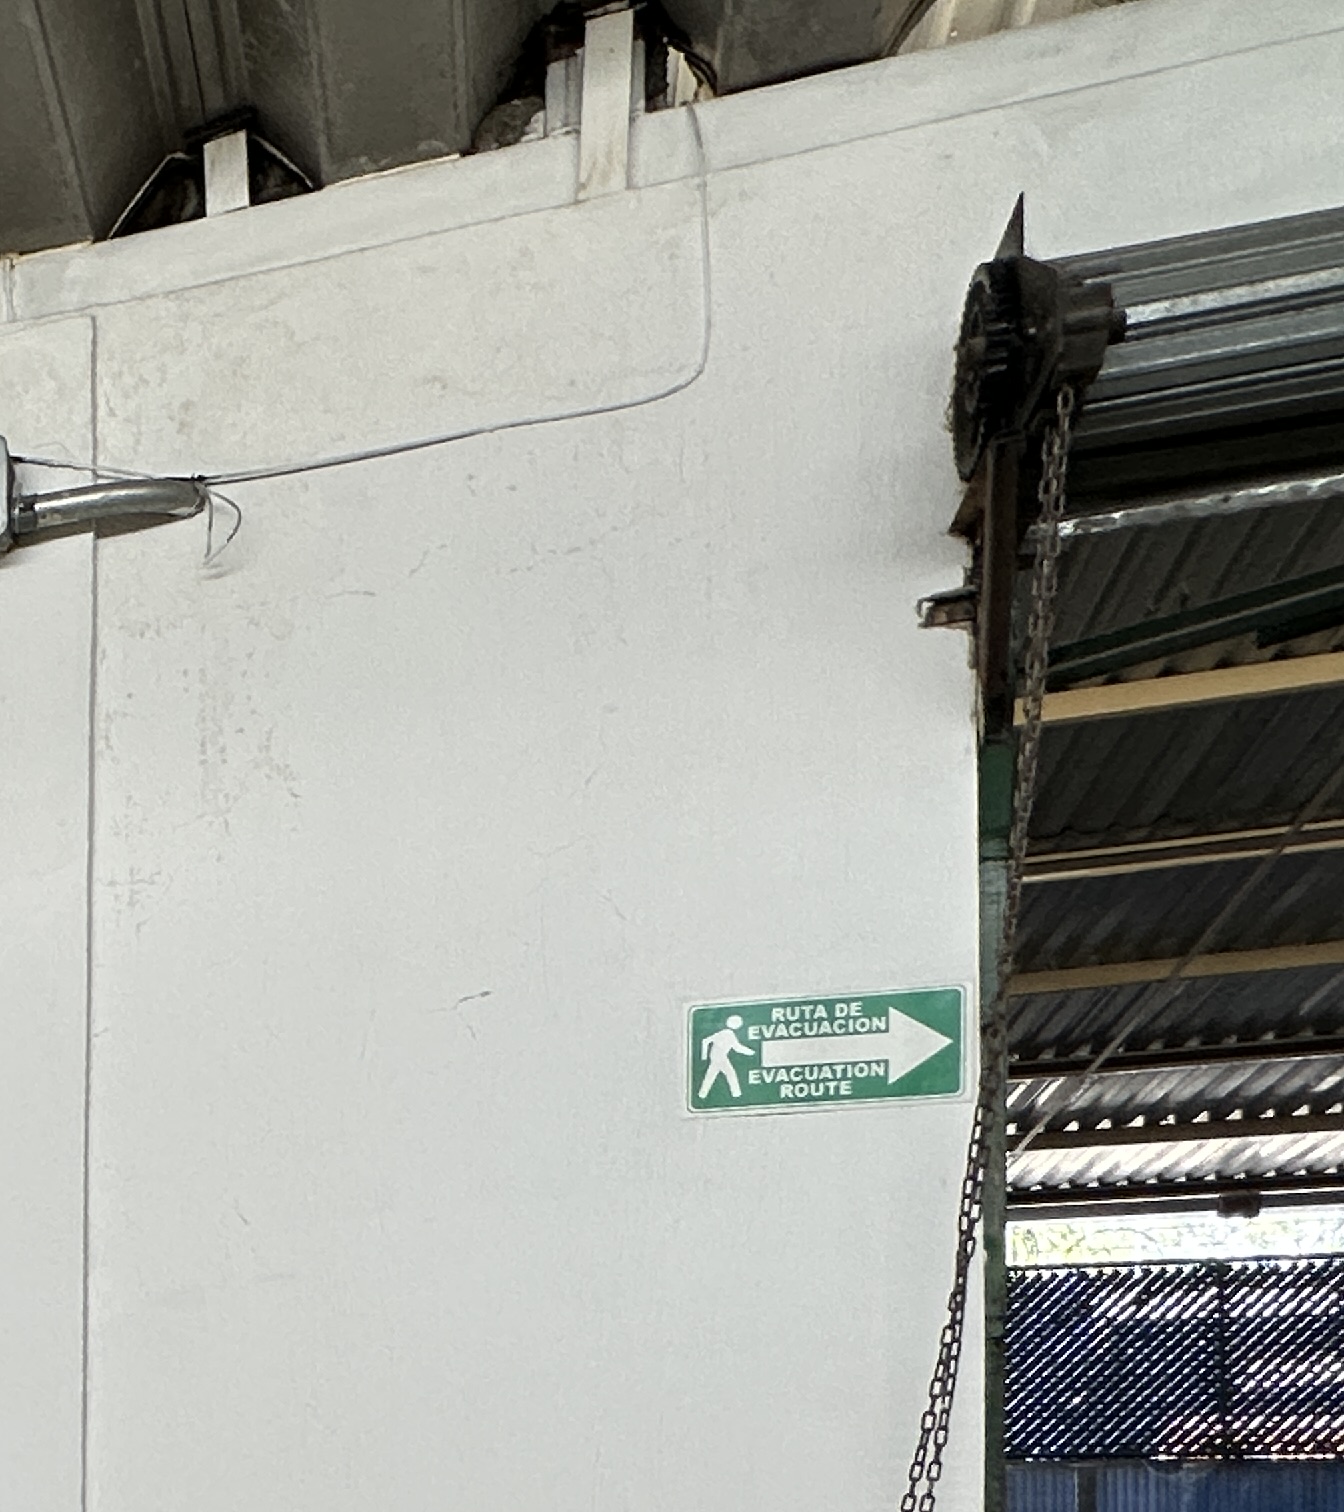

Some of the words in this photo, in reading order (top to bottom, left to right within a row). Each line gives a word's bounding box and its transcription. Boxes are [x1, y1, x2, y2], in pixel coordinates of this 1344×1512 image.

[772, 1004, 827, 1022] RUTA
[834, 1001, 863, 1018] DE
[748, 1017, 886, 1040] EVACUACION
[748, 1062, 886, 1084] EVACUATION
[779, 1080, 853, 1099] ROUTE
